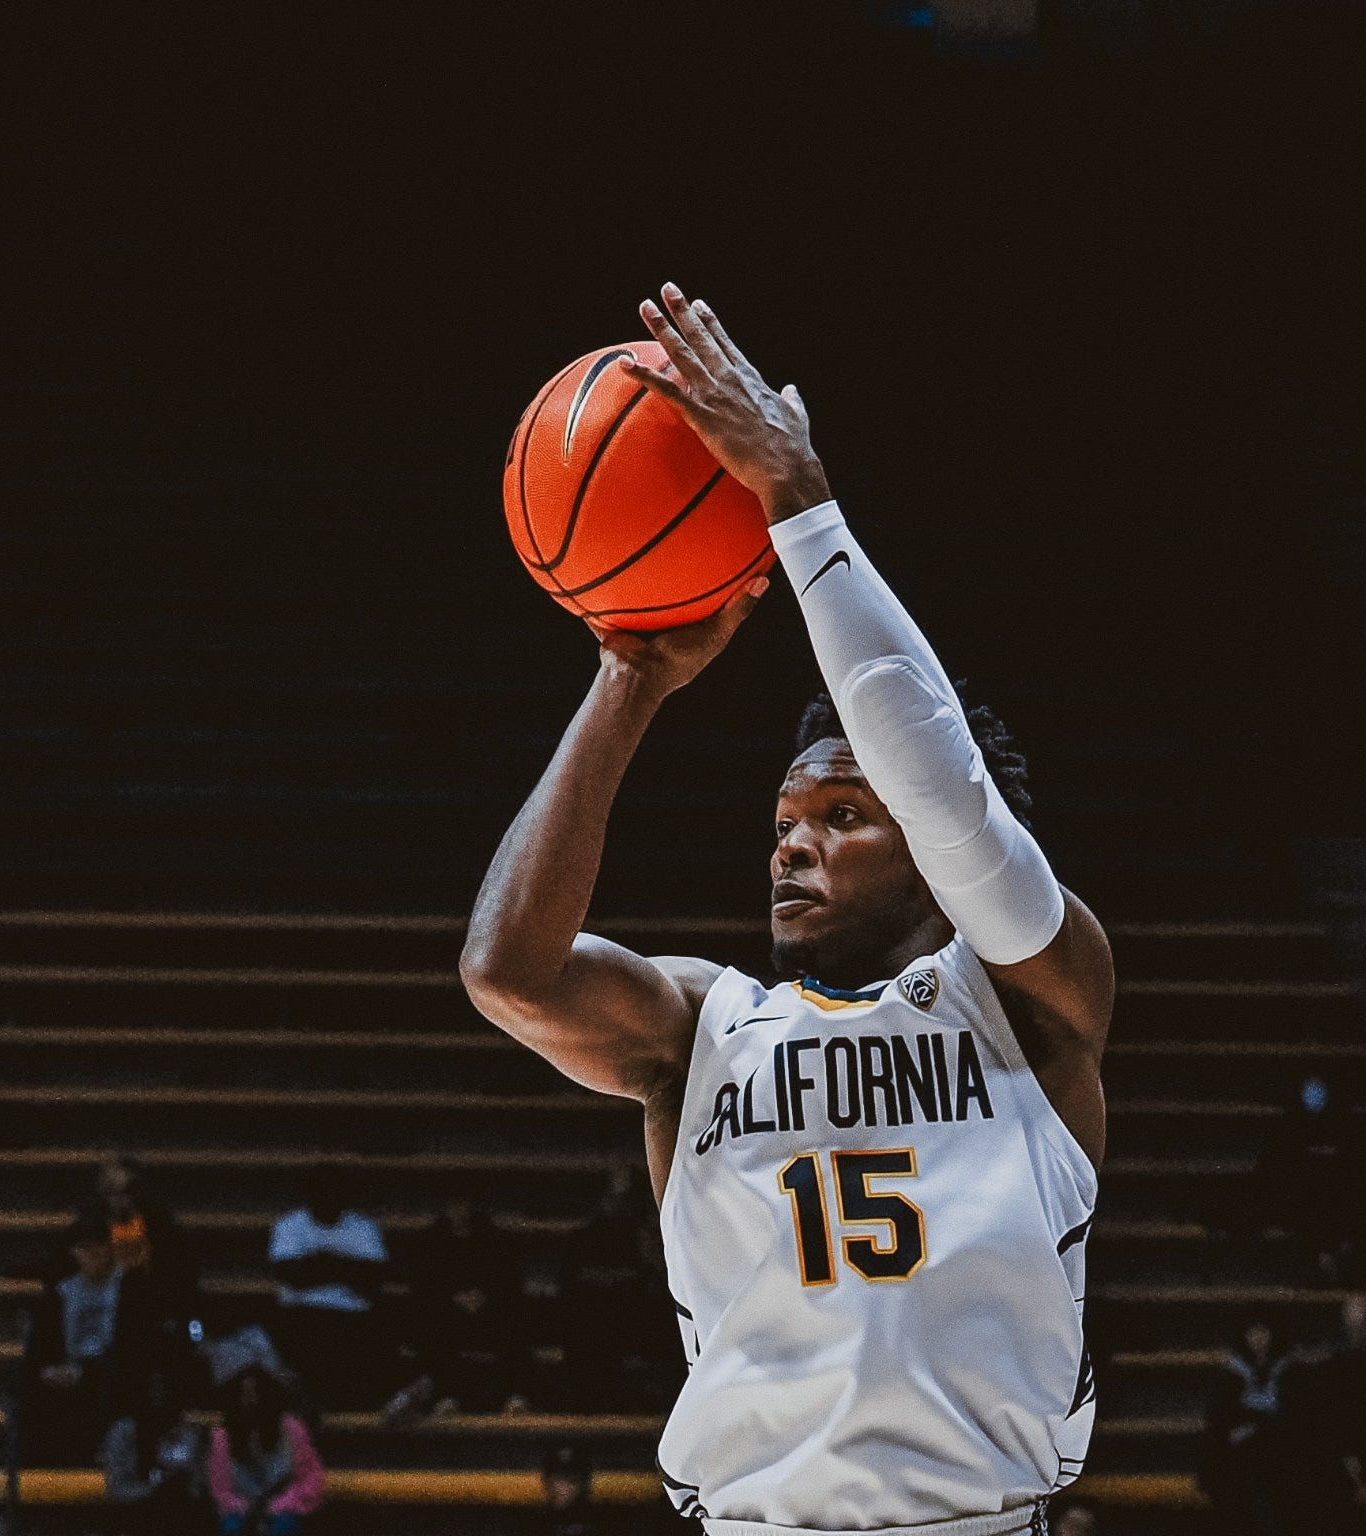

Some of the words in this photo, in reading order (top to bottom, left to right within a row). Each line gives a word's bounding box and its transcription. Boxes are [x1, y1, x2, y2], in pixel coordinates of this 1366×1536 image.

[900, 970, 936, 999] PAC
[913, 986, 932, 1003] 12
[695, 1030, 994, 1156] CALIFORNIA
[777, 1147, 927, 1287] 15
